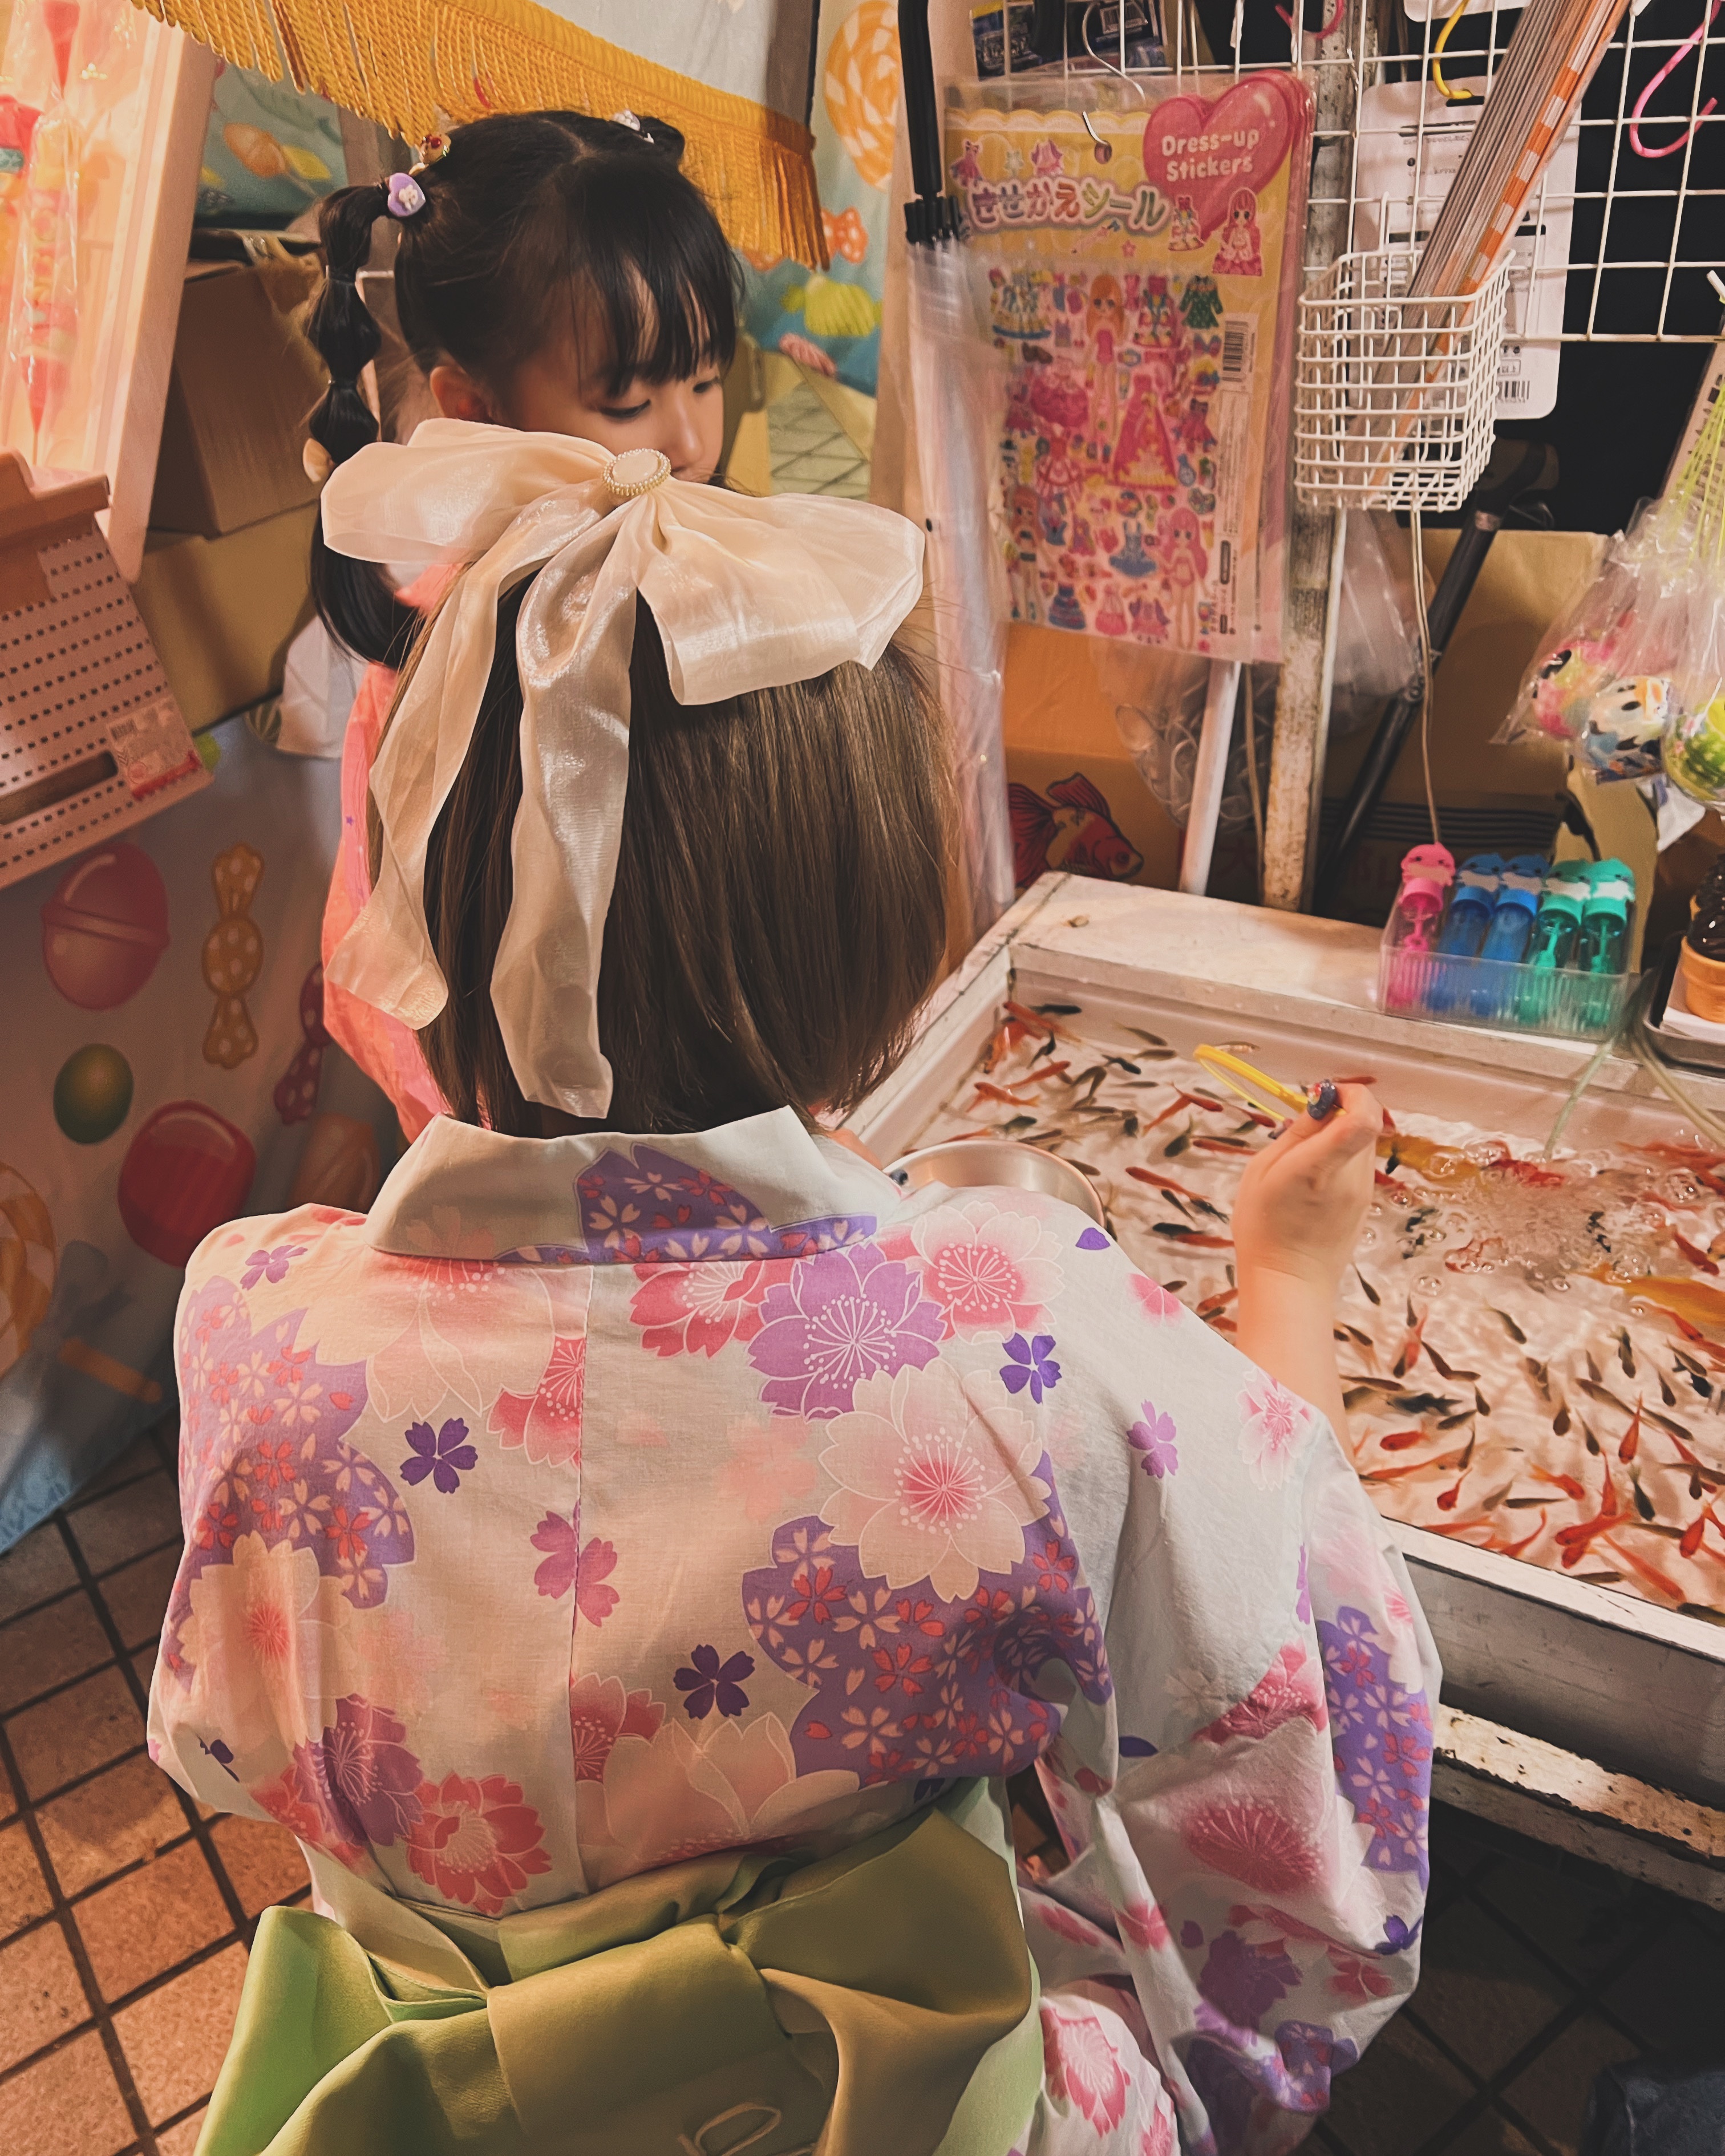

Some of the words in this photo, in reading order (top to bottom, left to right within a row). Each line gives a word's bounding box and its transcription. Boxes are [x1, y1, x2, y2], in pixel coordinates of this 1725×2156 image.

[1161, 129, 1259, 156] Dress-up
[1167, 155, 1253, 182] Stickers
[970, 179, 1167, 227] きせかえシール
